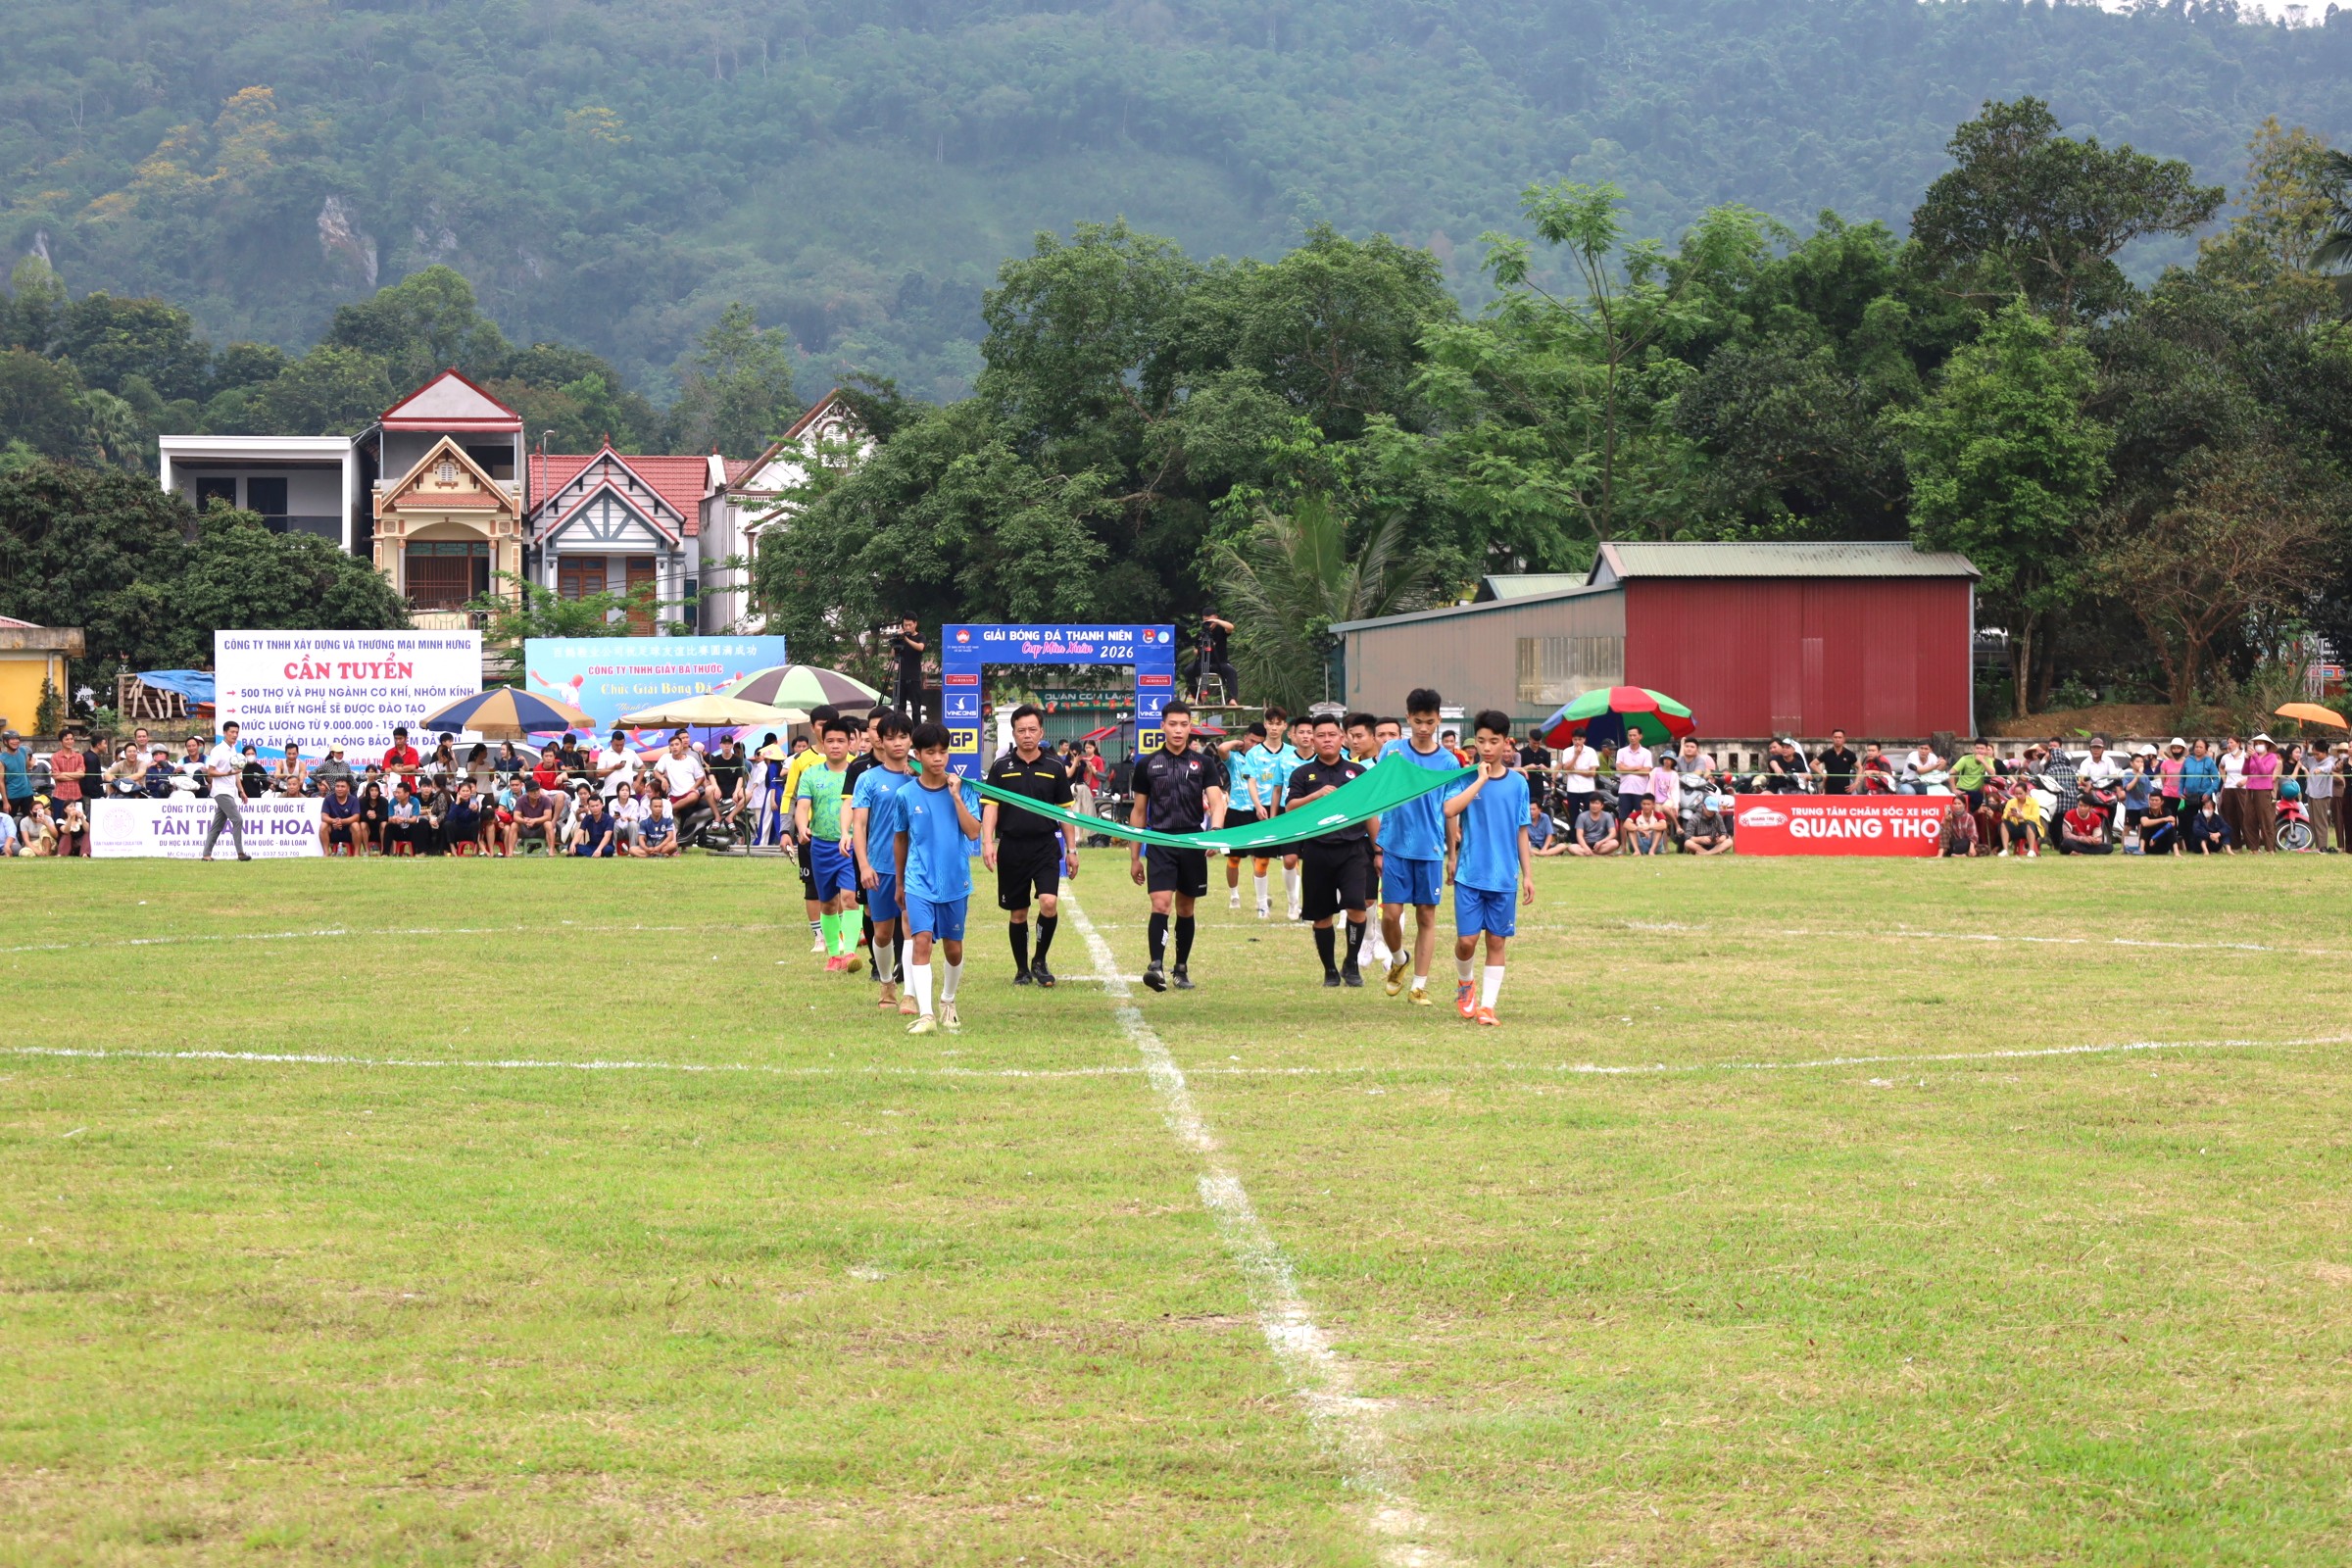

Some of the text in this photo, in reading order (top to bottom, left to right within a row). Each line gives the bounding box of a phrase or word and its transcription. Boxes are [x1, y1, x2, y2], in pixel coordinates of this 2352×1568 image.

[983, 628, 1133, 641] GIẢI BÓNG ĐÁ THANH NIÊN
[224, 638, 471, 652] CÔNG TY TNHH XÂY DỰNG VÀ THƯƠNG MẠI MINH HƯNG
[1022, 641, 1134, 659] Cup Mùa Xuân 2026
[283, 652, 413, 679] CẦN TUYỂN
[588, 664, 613, 675] CÔNG
[615, 665, 626, 675] TY
[629, 665, 653, 674] TNHH
[241, 685, 474, 700] 500 THỢ VÀ PHỤ NGÀNH CƠ KHÍ, NHÔM KÍNH
[601, 683, 628, 695] Chúc
[662, 682, 692, 696] Bóng
[695, 681, 712, 694] Đá
[241, 700, 426, 715] CHƯA BIẾT NGHỀ SẼ ĐƯỢC ĐÀO TẠO
[241, 719, 266, 730] MỨC
[269, 720, 306, 730] LƯƠNG
[309, 718, 320, 730] TỪ
[323, 721, 373, 730] 9.000.000
[382, 720, 423, 730] 15.000.
[241, 737, 265, 747] BAO
[268, 735, 282, 747] ĂN
[297, 737, 308, 747] ĐI
[311, 737, 329, 749] LẠI,
[368, 734, 391, 746] BẢO
[951, 732, 973, 747] GP
[1143, 733, 1165, 748] GP
[162, 804, 183, 812] CÔNG
[196, 802, 207, 812] CỔ
[257, 804, 271, 814] LỰC
[273, 803, 294, 812] QUỐC
[297, 802, 306, 812] TẾ
[1826, 806, 1846, 815] TÂM
[1849, 807, 1880, 815] CHĂM
[1922, 807, 1939, 815] HƠI
[152, 815, 190, 835] TÂN
[270, 819, 315, 835] HOA
[1789, 817, 1940, 843] QUANG THỌ
